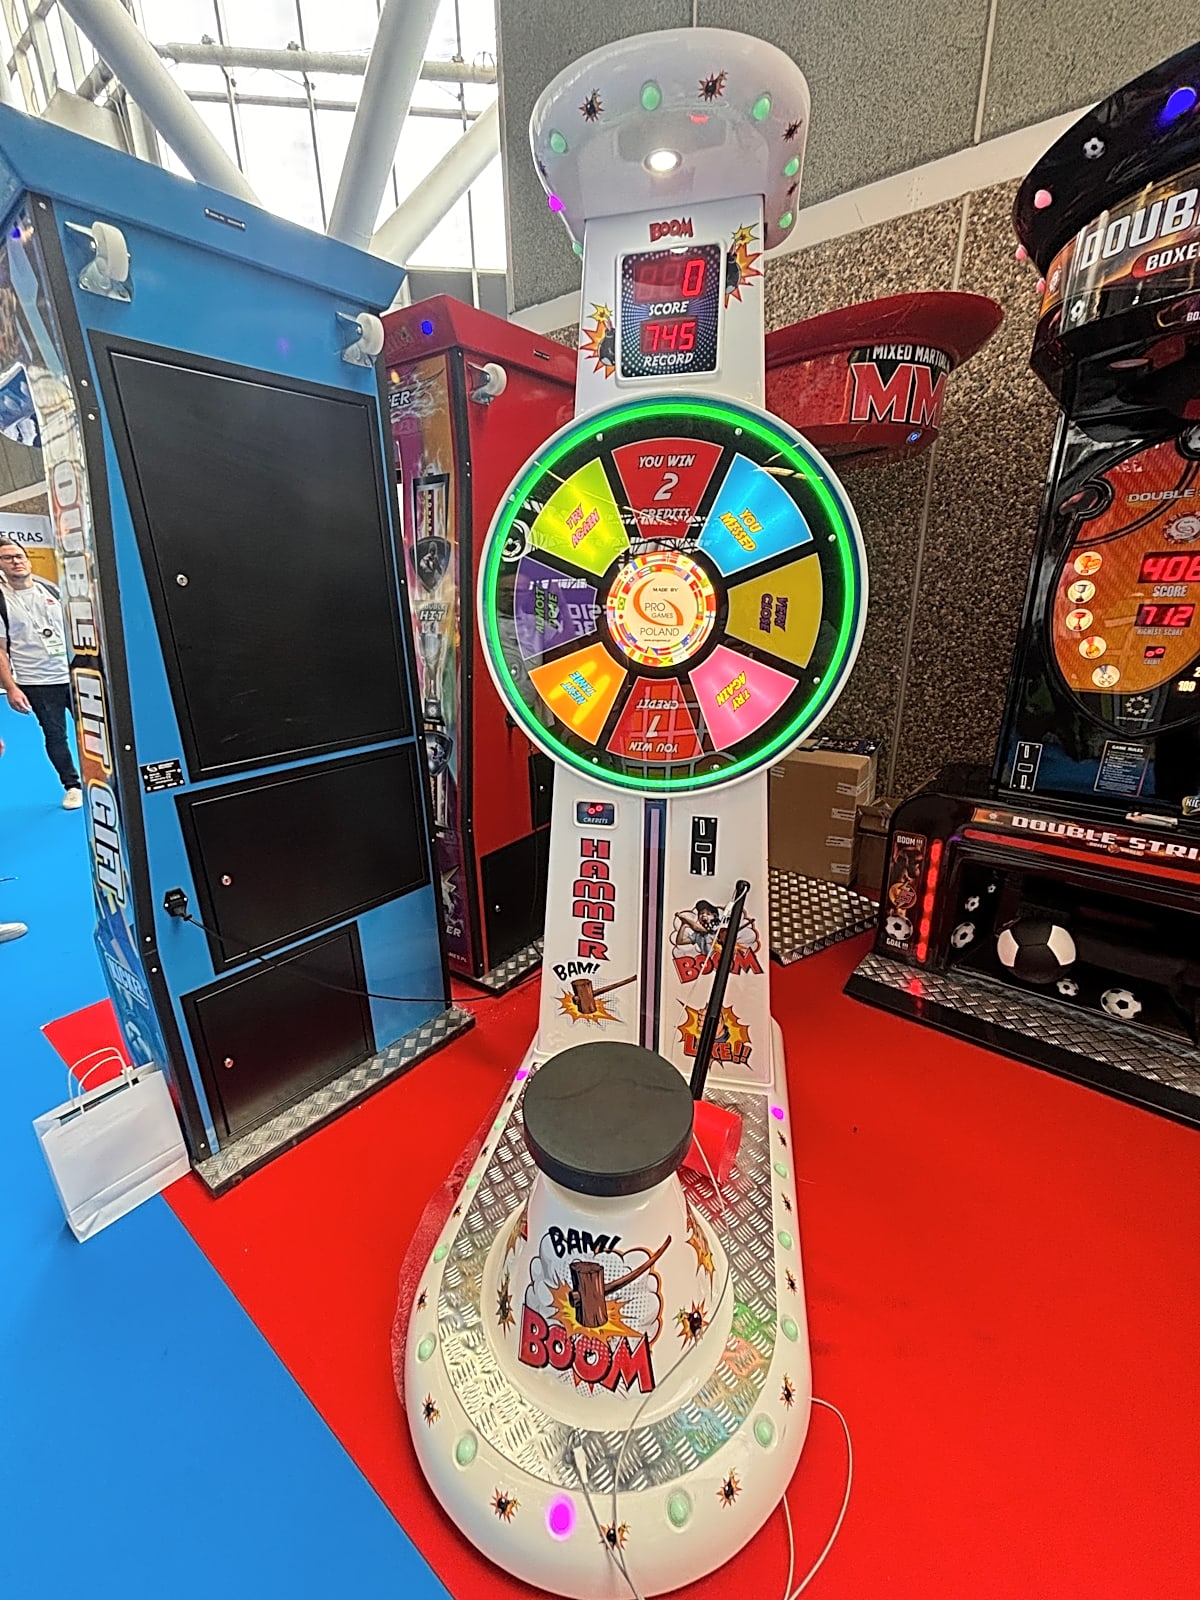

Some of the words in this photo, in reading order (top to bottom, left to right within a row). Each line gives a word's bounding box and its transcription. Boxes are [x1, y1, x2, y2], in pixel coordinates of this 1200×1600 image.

[649, 217, 694, 242] BOOM
[1080, 188, 1200, 271] DOUB
[1145, 242, 1200, 272] BOXE
[682, 259, 705, 297] 0
[649, 301, 690, 316] SCORE
[646, 321, 697, 351] 745
[643, 353, 694, 368] RECORD
[873, 344, 913, 366] MIXED
[638, 454, 665, 469] YOU
[667, 453, 697, 468] WIN
[653, 471, 680, 501] 2
[1127, 488, 1196, 502] DOUBLE
[565, 502, 584, 530] TRY
[639, 507, 692, 520] CREDITS
[738, 507, 764, 533] YOU
[571, 508, 600, 549] AGAIN
[718, 511, 757, 551] MISSED
[1152, 585, 1188, 597] SCORE
[420, 610, 445, 621] HIT
[534, 586, 546, 634] ALMOST
[644, 602, 666, 612] PRO
[759, 593, 773, 633] CLOSE
[774, 597, 788, 632] VERY
[1143, 606, 1194, 626] 712
[640, 627, 680, 636] POLAND
[560, 682, 588, 705] NEXT
[568, 670, 596, 697] TIME
[715, 671, 747, 707] AGAIN
[636, 698, 680, 710] CREDIT
[732, 690, 751, 711] TRY
[76, 672, 112, 770] HIT
[628, 741, 654, 752] WIN
[656, 742, 679, 753] YOU
[1011, 815, 1118, 845] DOUBLE
[91, 782, 126, 905] GIFT
[572, 837, 616, 961] HAMMER
[886, 937, 901, 949] GOAL
[552, 961, 600, 981] BAM!
[548, 1226, 622, 1258] BAM!
[518, 1303, 656, 1393] BOOM
